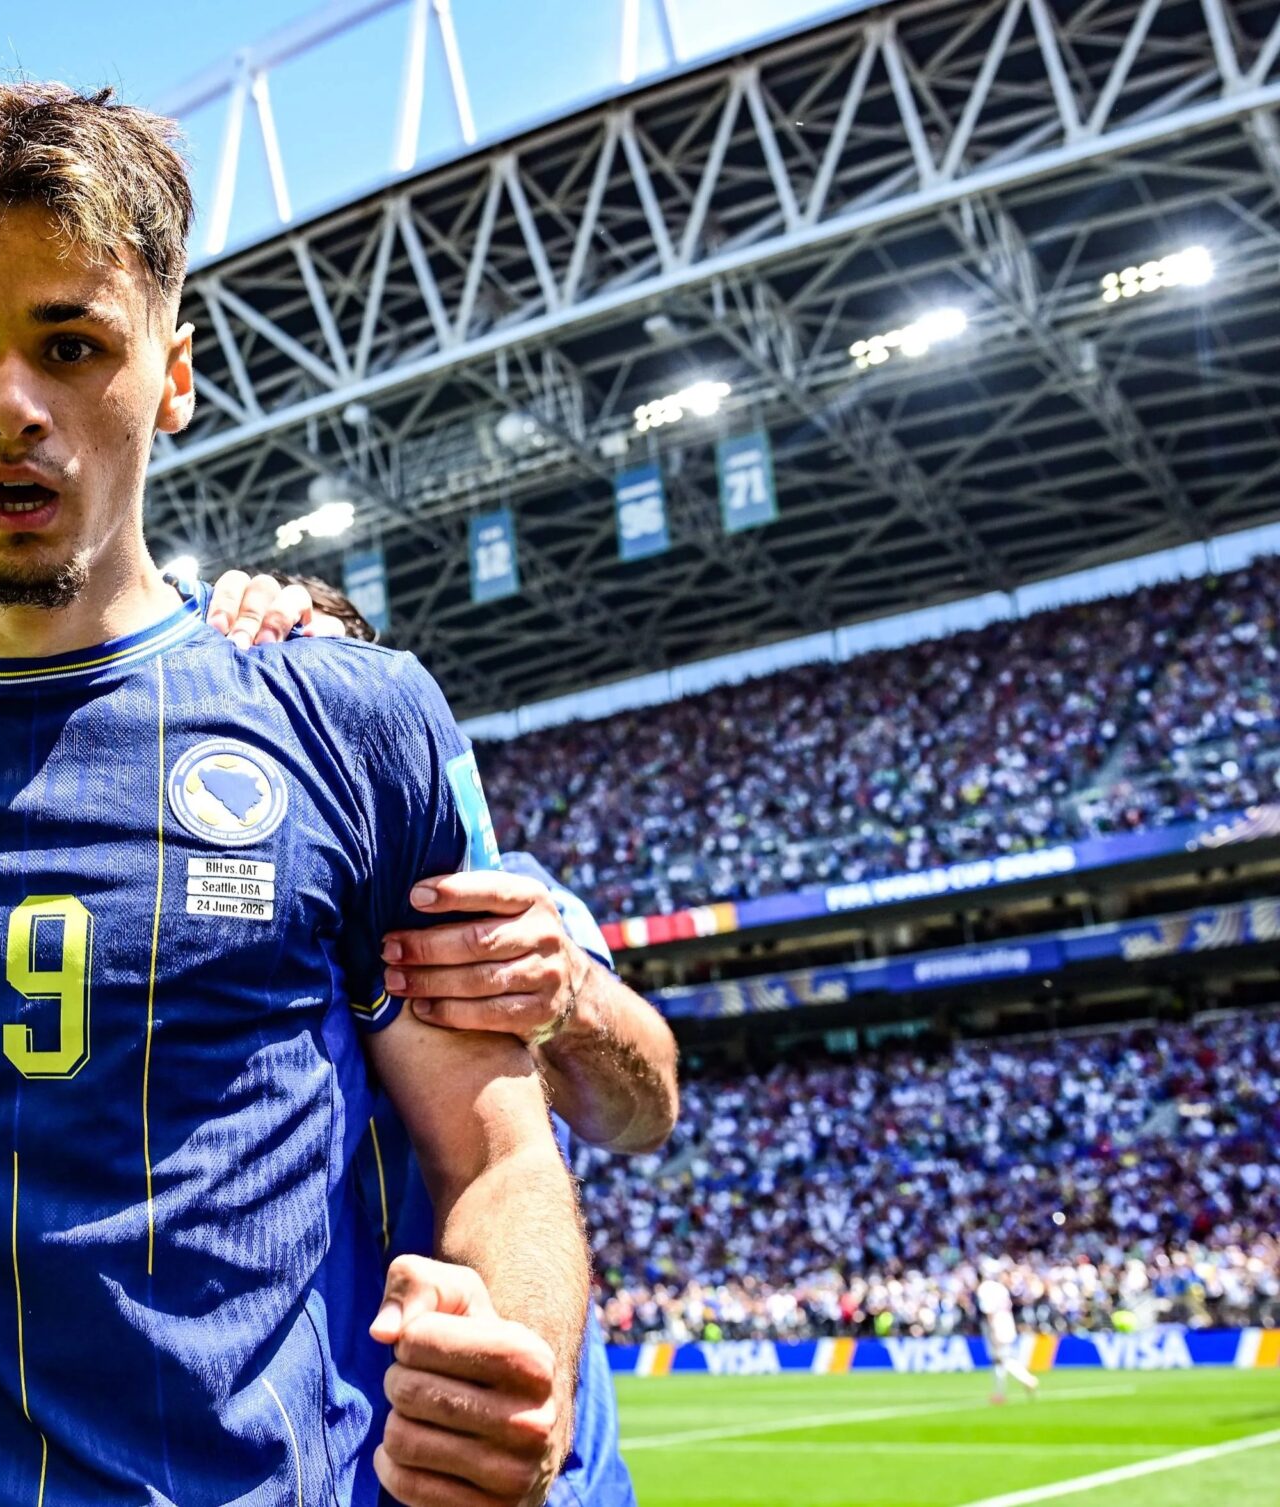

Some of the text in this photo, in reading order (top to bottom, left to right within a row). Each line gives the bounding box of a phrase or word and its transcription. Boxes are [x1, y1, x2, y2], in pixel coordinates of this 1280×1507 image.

[725, 466, 768, 510] 71
[206, 862, 259, 876] BIH vs. QAT
[196, 899, 265, 915] 24 June 2026
[700, 1340, 781, 1374] VISA
[884, 1336, 976, 1373] VISA
[1090, 1331, 1195, 1368] VISA
